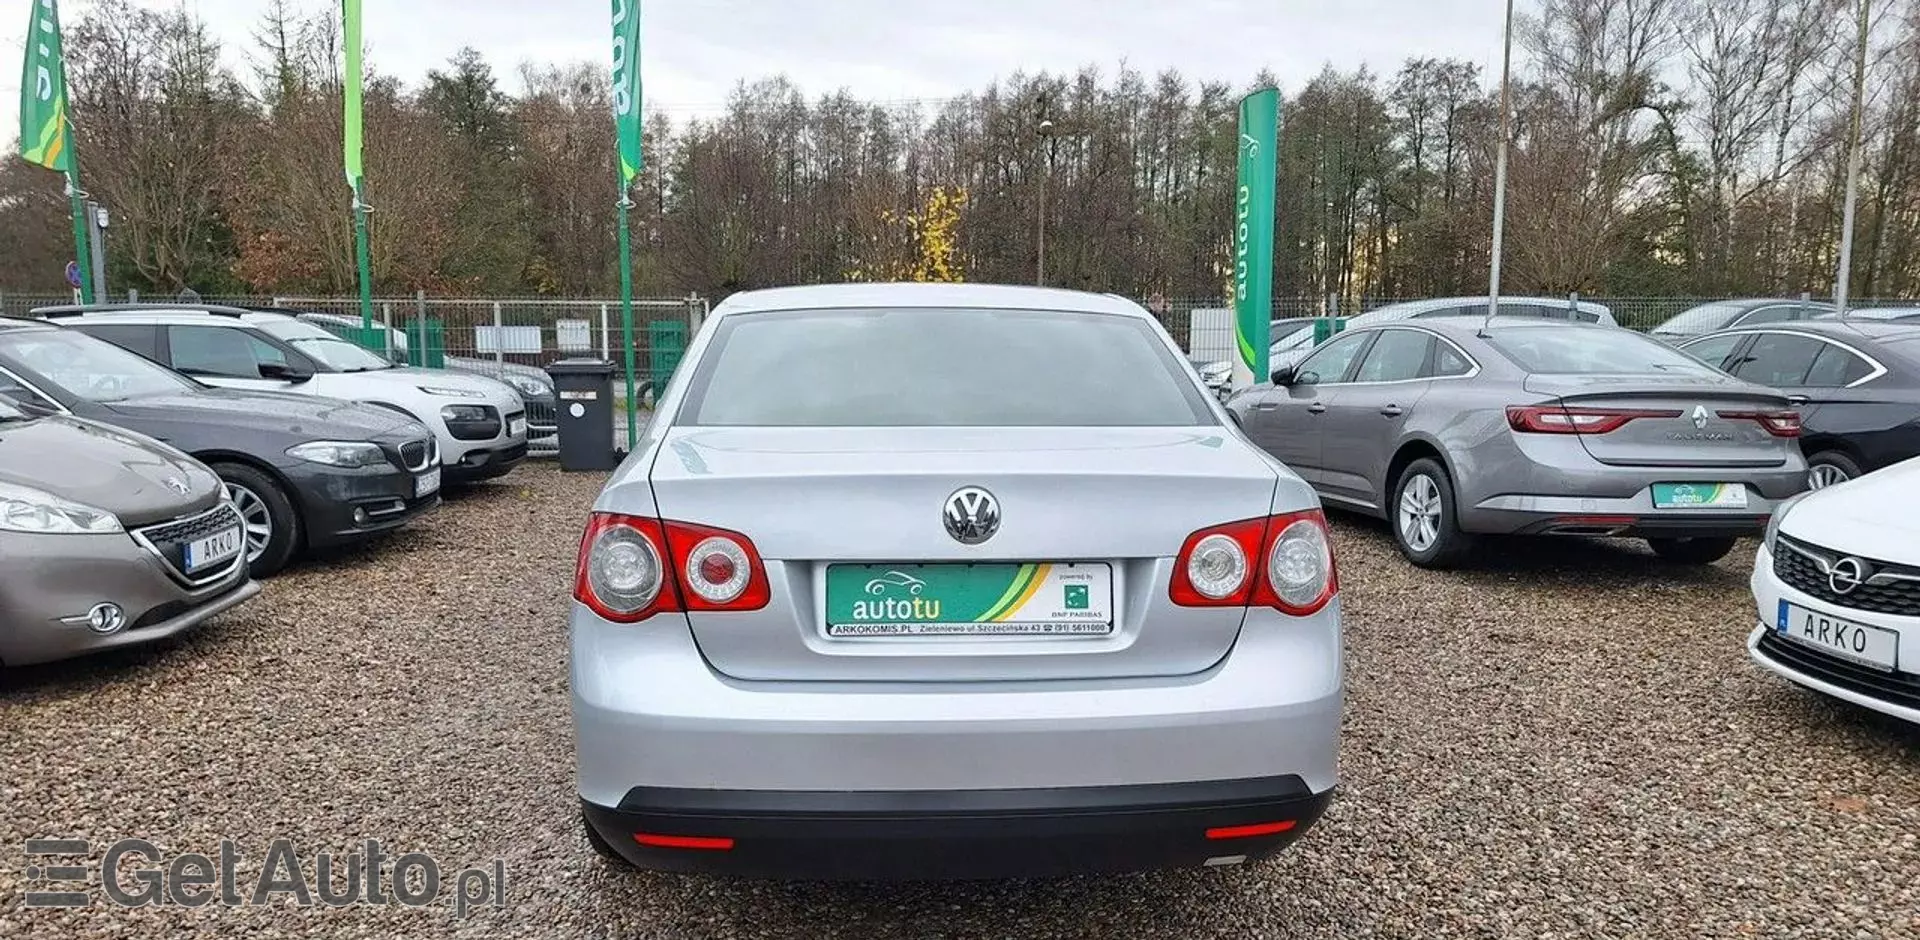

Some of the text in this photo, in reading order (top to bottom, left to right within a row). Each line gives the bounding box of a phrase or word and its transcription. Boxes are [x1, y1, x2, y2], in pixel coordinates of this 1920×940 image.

[1238, 185, 1249, 301] autotu
[203, 532, 232, 560] ARKO
[853, 597, 941, 619] autotu
[835, 625, 913, 634] ARKOKOMIS.PL
[1804, 614, 1866, 653] ARKO
